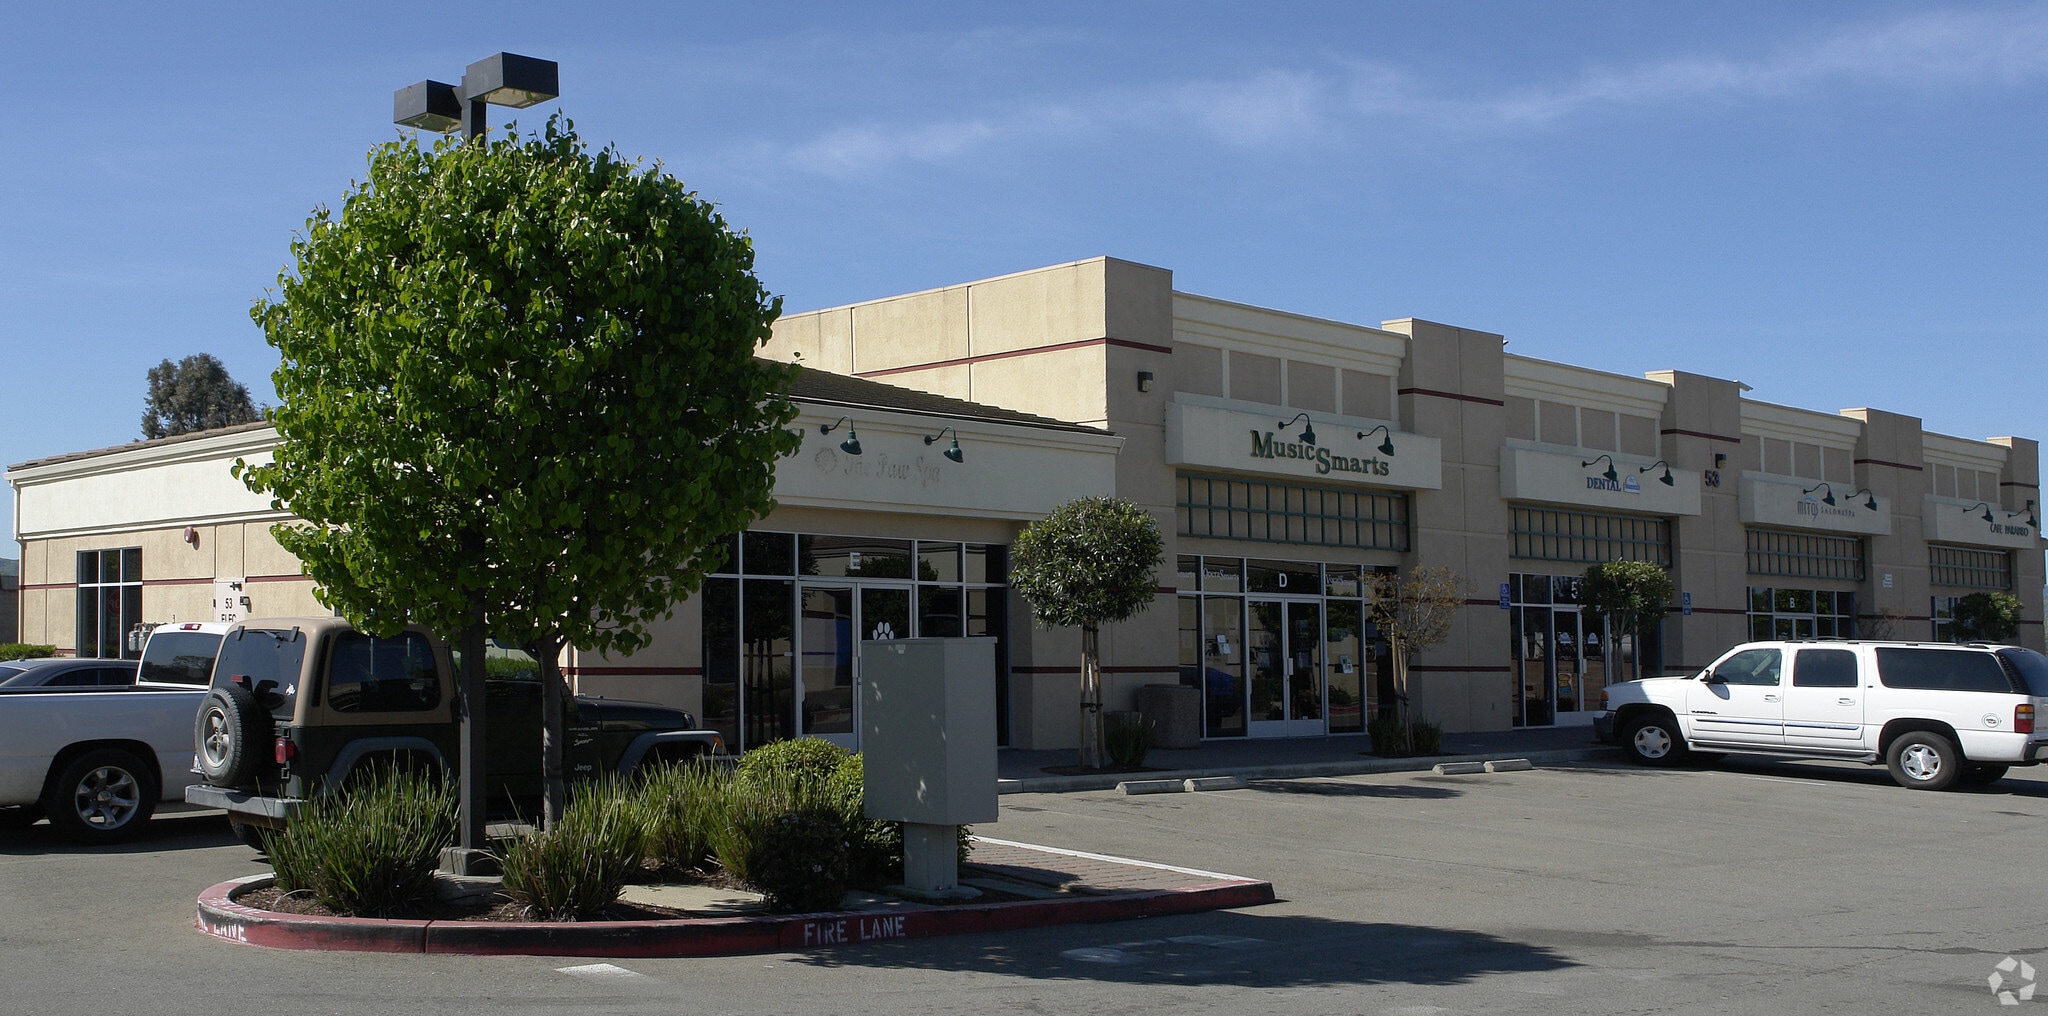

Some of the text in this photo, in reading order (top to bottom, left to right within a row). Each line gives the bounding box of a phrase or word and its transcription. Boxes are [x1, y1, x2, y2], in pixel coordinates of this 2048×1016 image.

[1250, 430, 1390, 475] MusicSmarts
[876, 453, 911, 481] Paw
[914, 455, 941, 487] Spa
[1704, 469, 1720, 488] 53
[1586, 476, 1622, 492] DENTAL
[1797, 500, 1819, 521] MITOS
[849, 552, 861, 570] E
[1278, 573, 1288, 588] D
[225, 597, 233, 609] 53
[1789, 597, 1795, 609] B
[574, 763, 592, 772] Jeep
[213, 922, 248, 942] LANE
[804, 916, 906, 946] FIRE LANE
